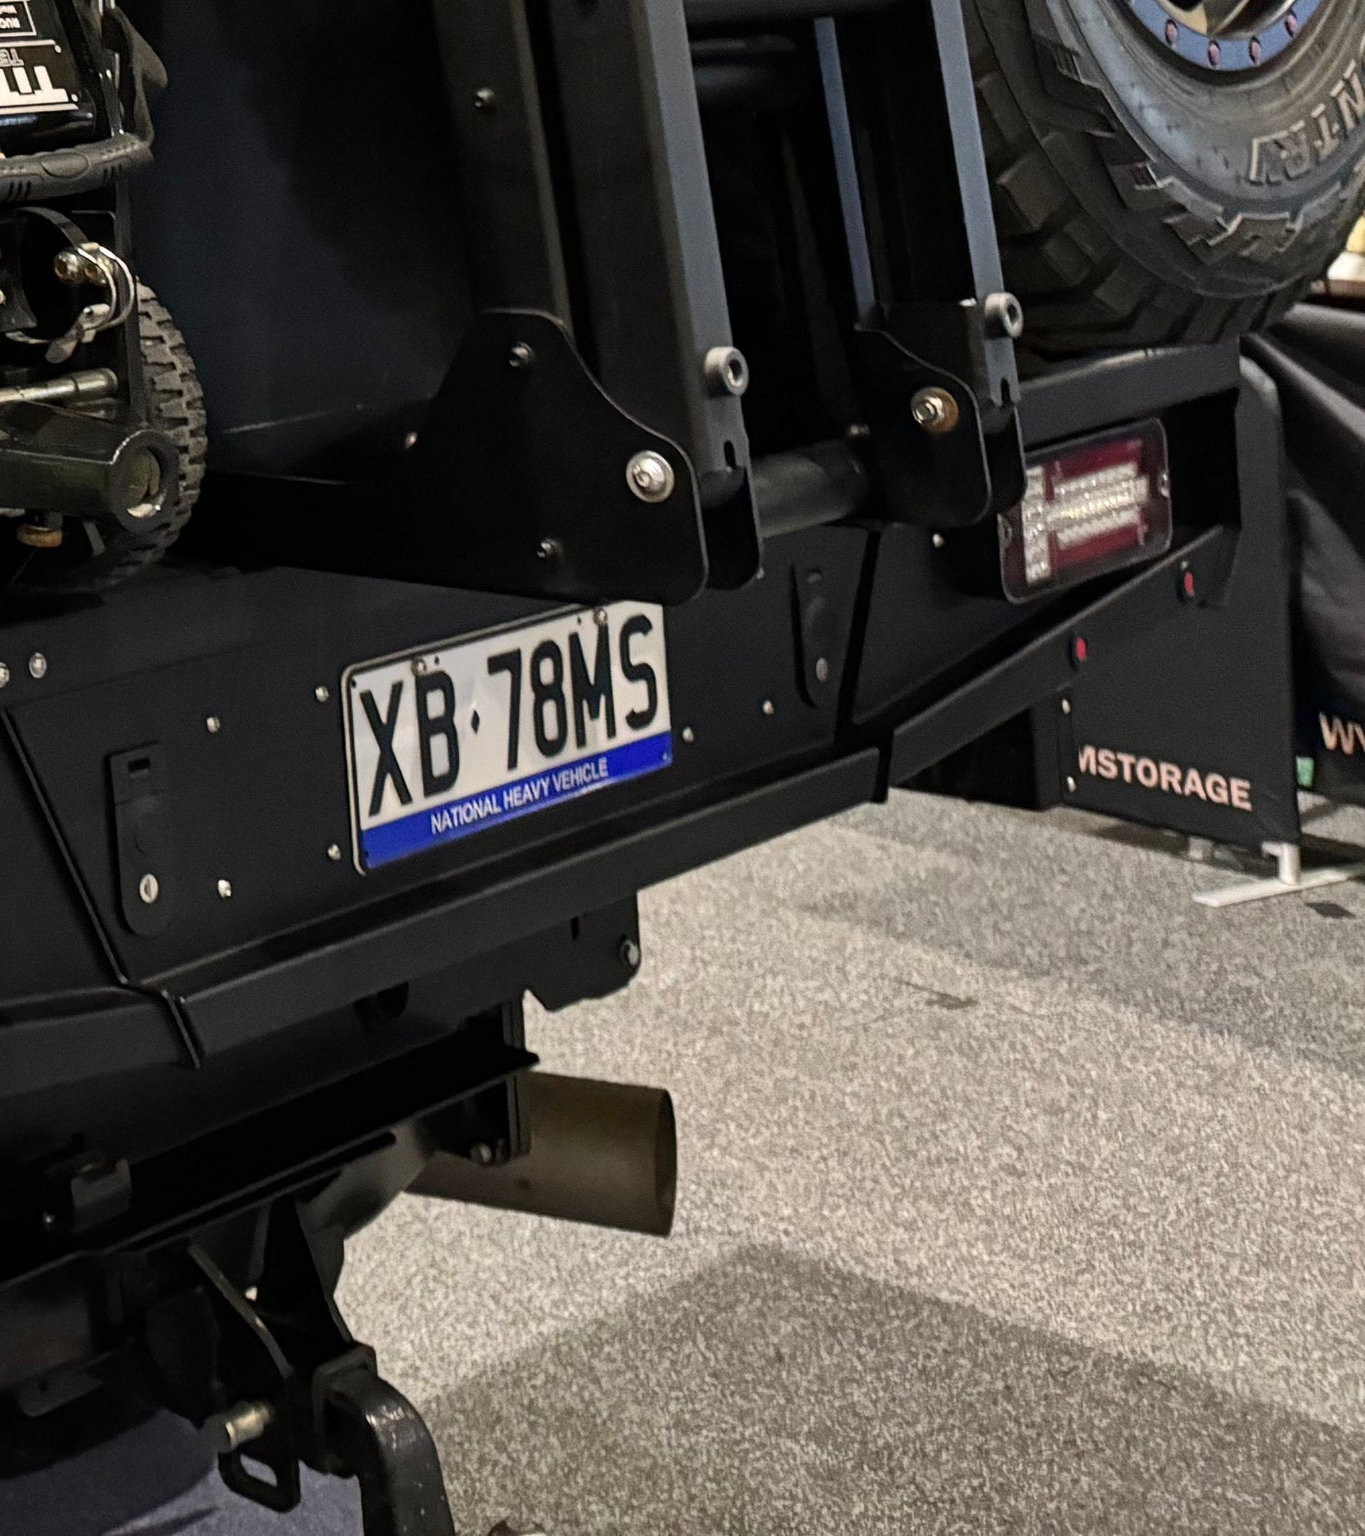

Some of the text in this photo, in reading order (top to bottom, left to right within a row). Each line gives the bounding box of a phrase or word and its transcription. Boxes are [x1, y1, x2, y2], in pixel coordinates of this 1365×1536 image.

[430, 756, 609, 836] NATIONAL HEAVY VEHICLE
